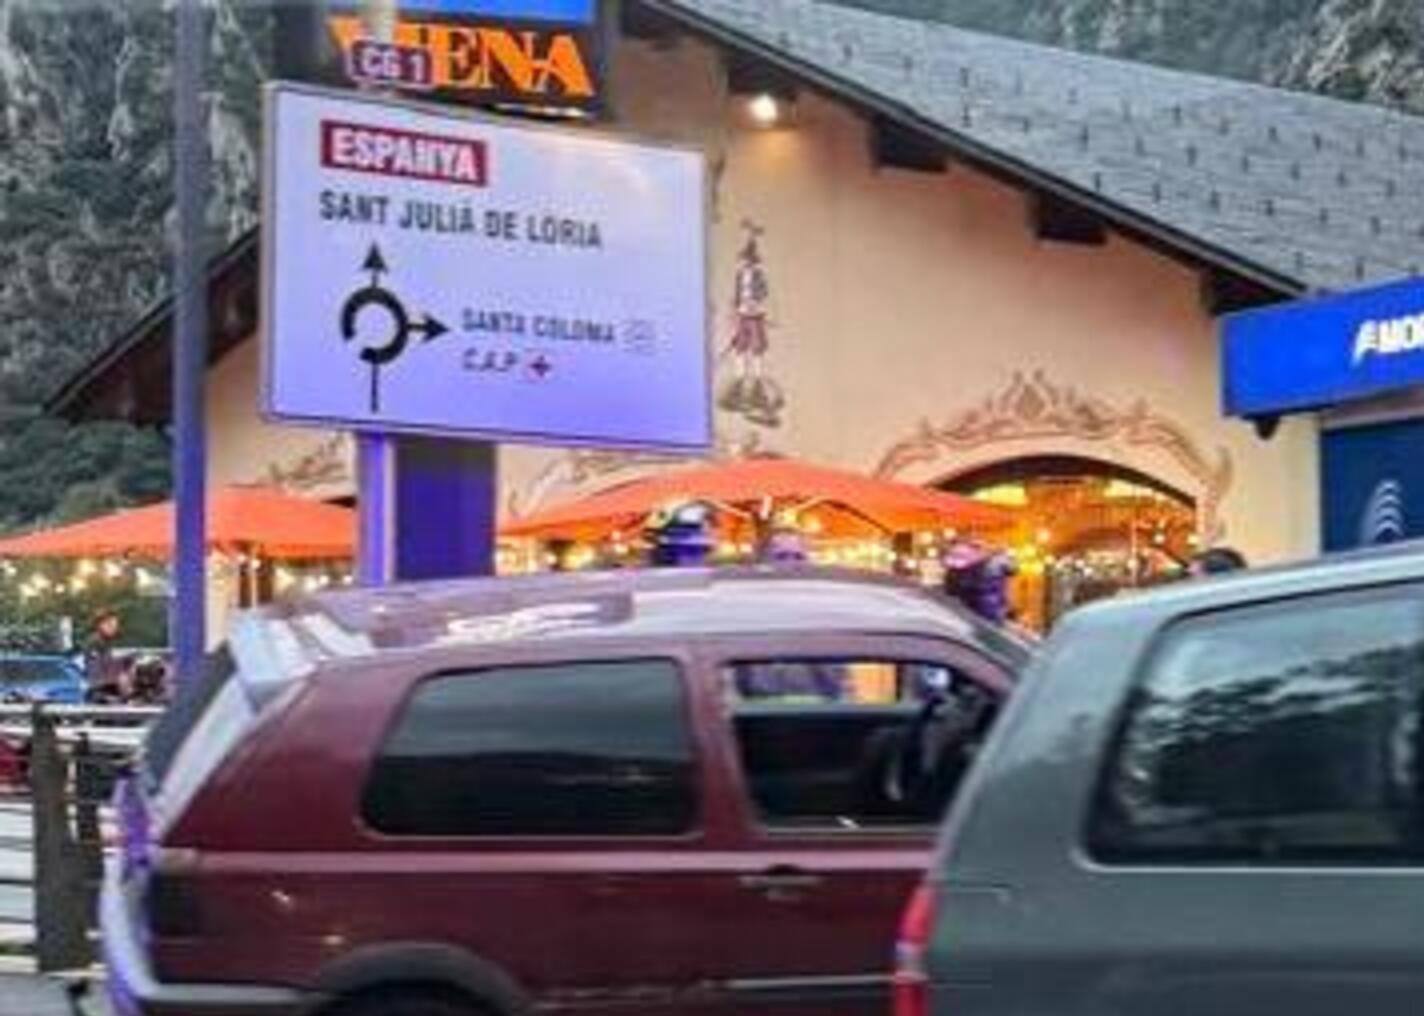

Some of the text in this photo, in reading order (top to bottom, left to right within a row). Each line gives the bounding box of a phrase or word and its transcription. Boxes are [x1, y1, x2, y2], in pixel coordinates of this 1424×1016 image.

[408, 53, 426, 81] 1
[330, 127, 478, 181] ESPANYA
[320, 190, 389, 225] SANT
[484, 210, 518, 241] DE
